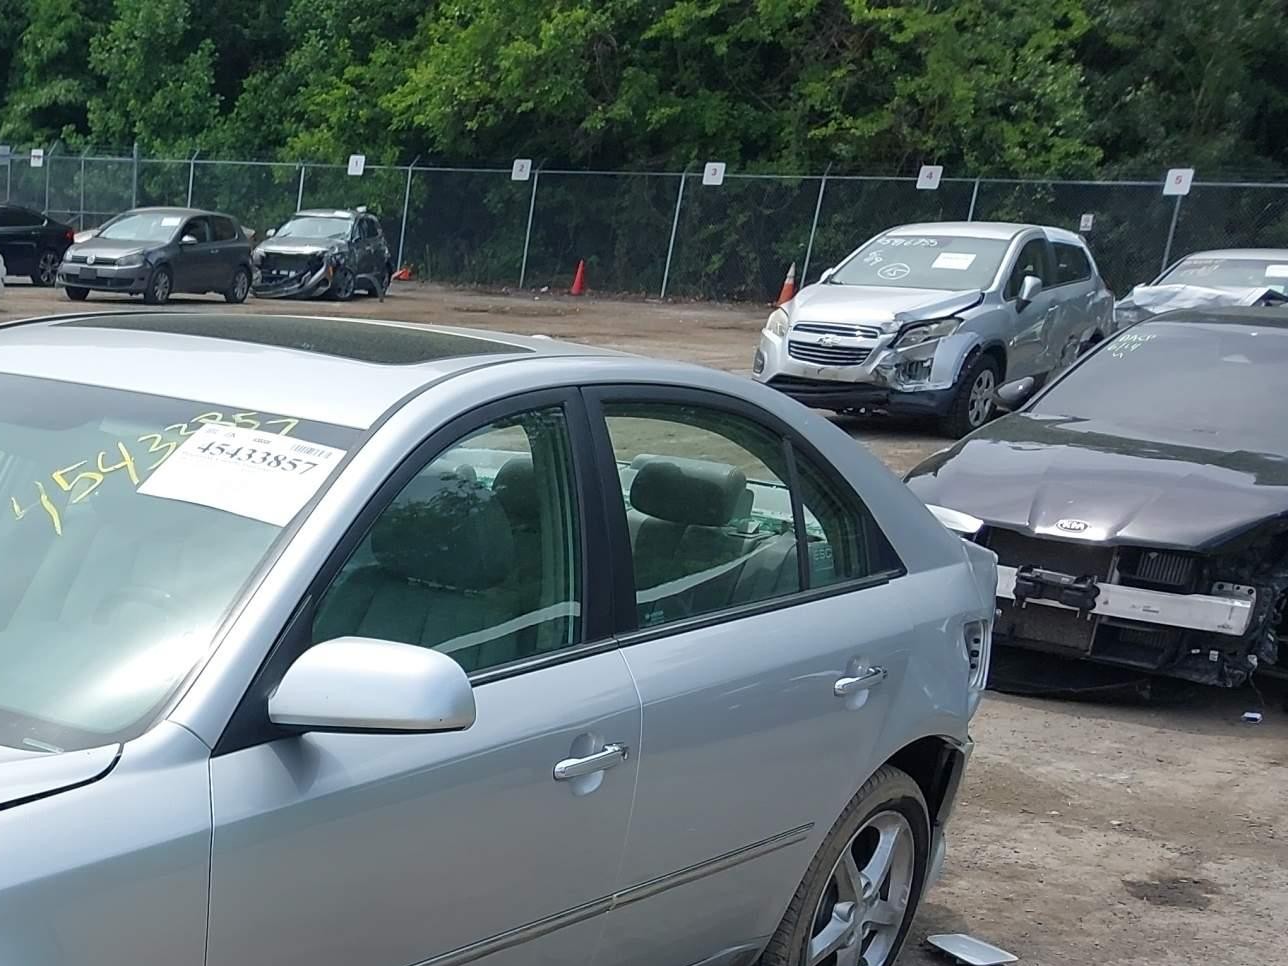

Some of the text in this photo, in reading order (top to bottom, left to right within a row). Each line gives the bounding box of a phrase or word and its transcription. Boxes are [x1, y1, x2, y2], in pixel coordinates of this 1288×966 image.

[711, 167, 718, 176] 3
[925, 171, 933, 180] 4
[197, 441, 319, 475] 45433857
